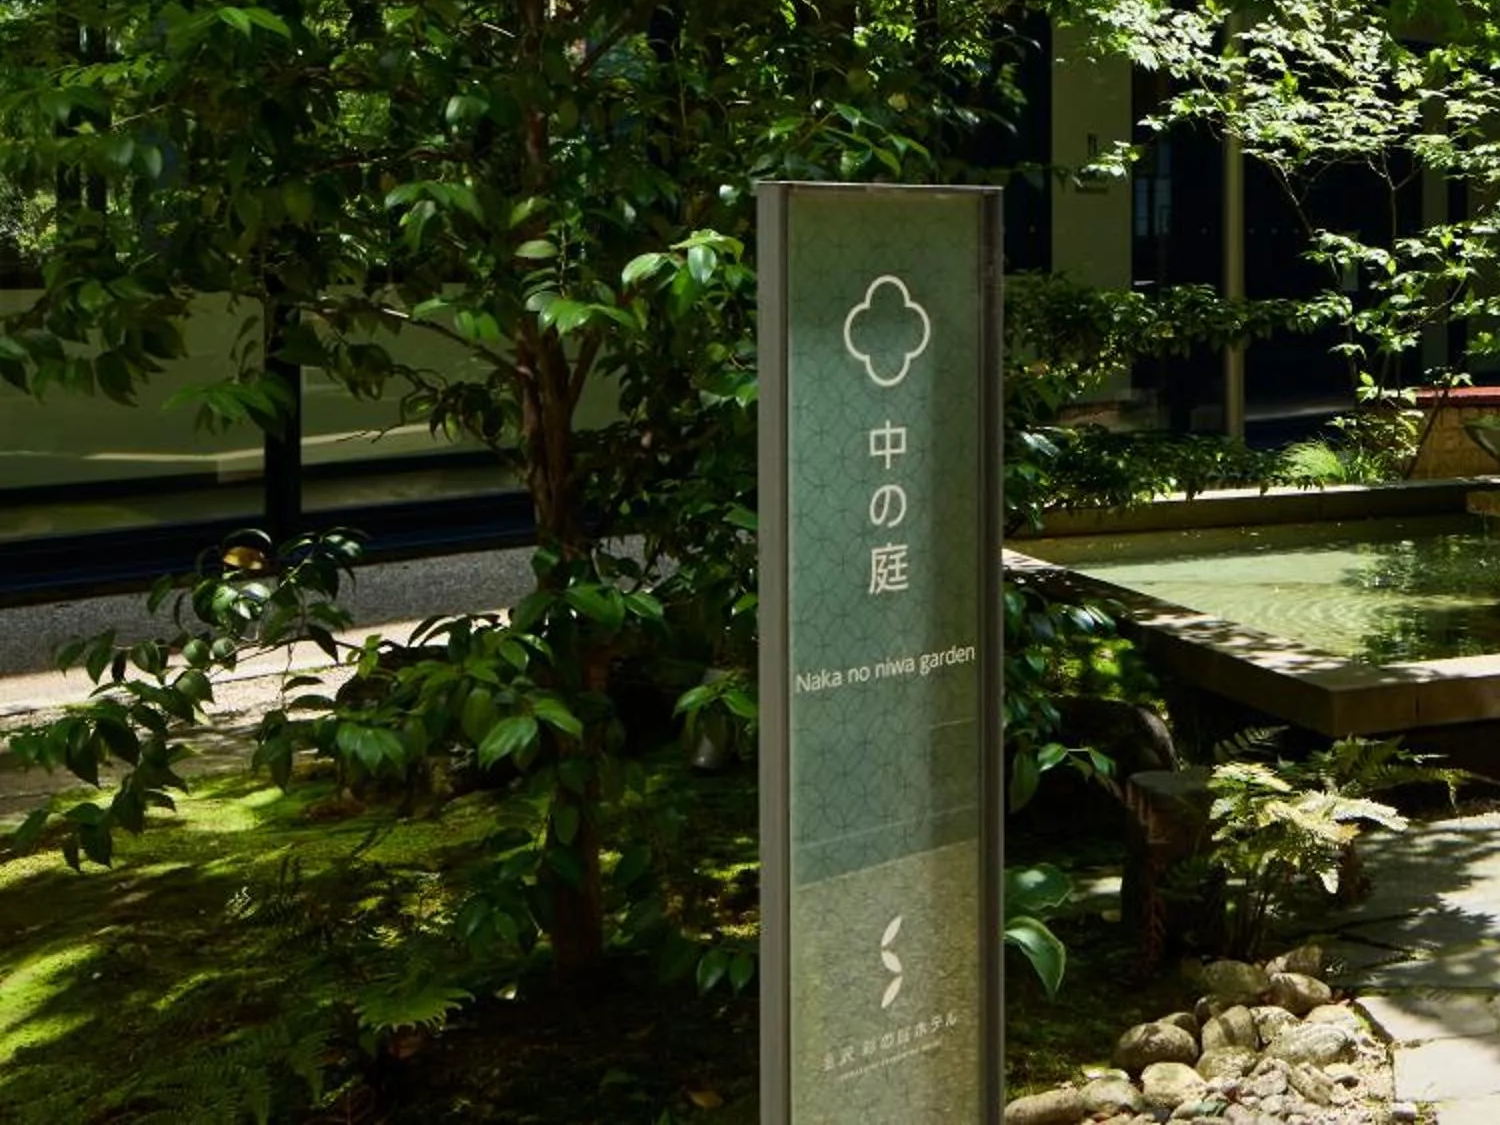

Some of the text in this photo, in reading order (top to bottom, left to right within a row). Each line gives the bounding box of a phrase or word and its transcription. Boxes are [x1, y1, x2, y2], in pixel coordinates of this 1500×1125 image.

[869, 419, 909, 595] 中の庭
[796, 644, 976, 693] Naka no niwa garden
